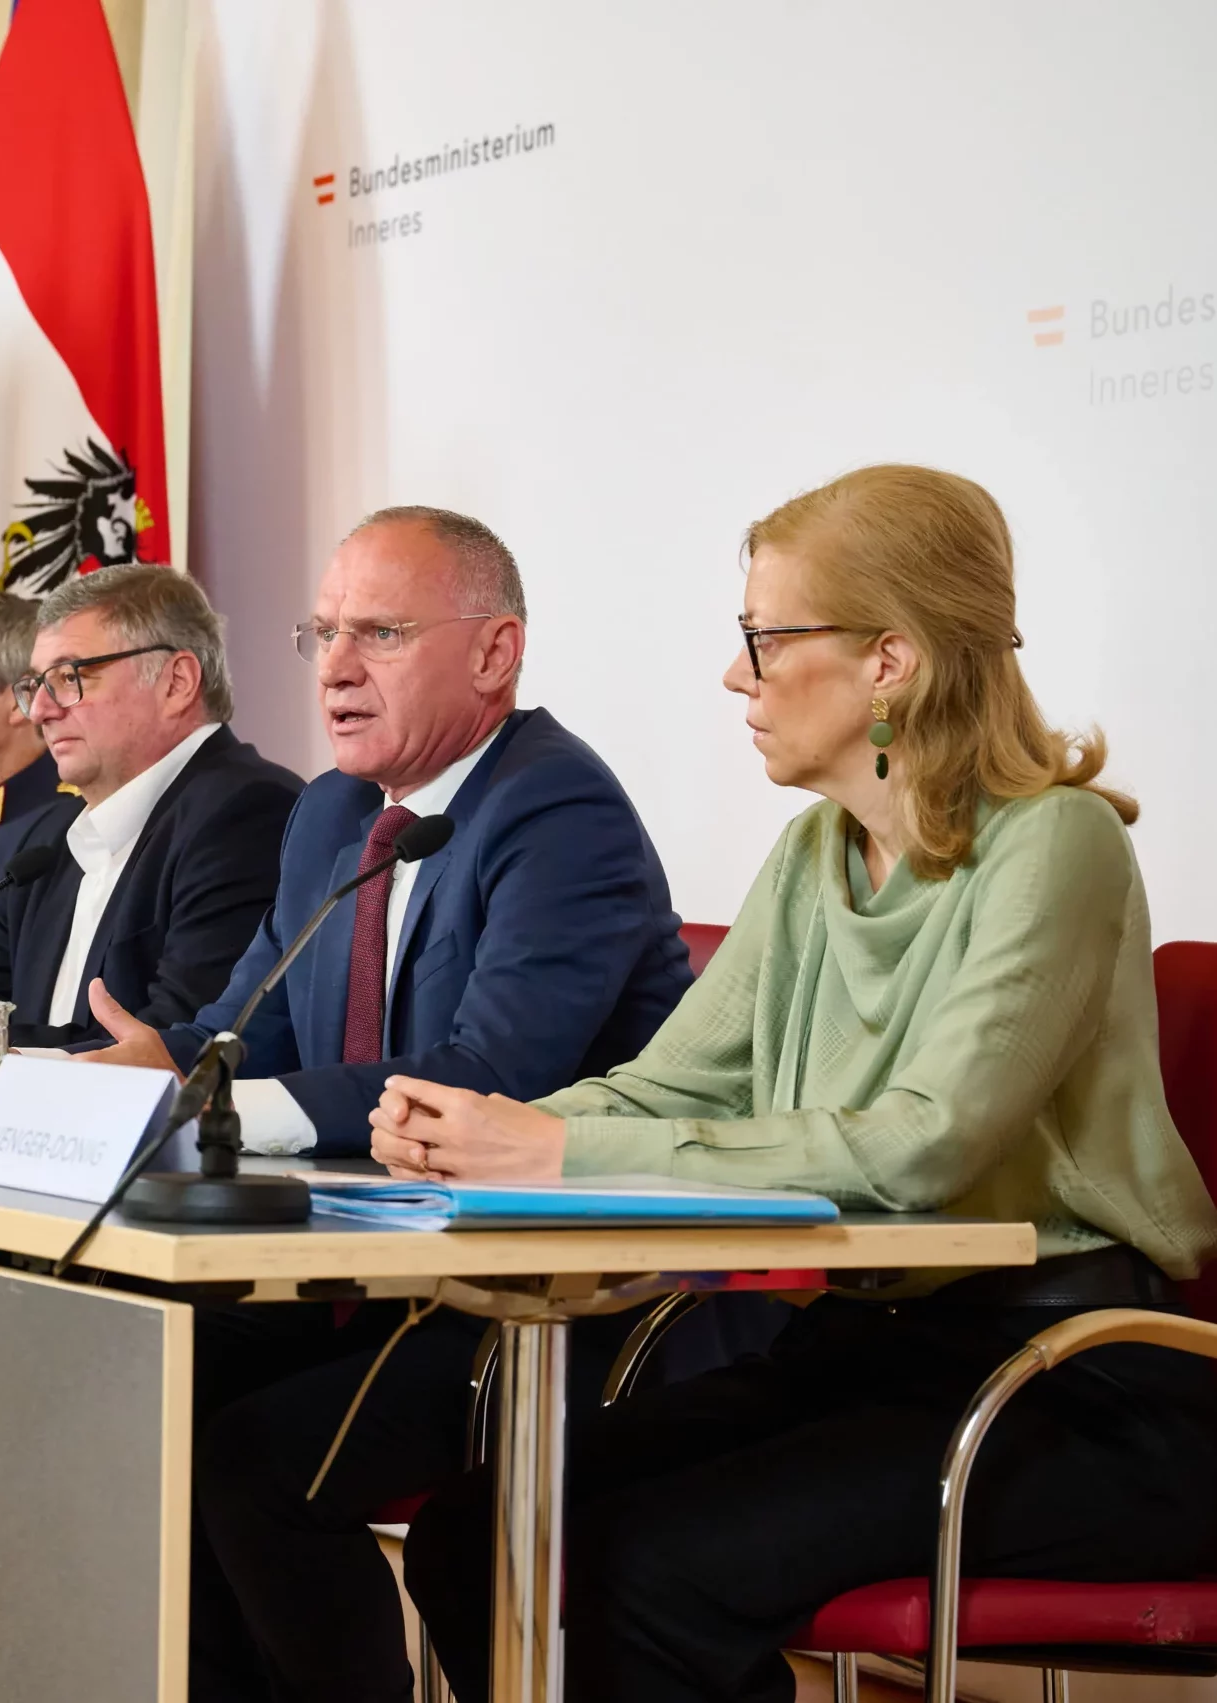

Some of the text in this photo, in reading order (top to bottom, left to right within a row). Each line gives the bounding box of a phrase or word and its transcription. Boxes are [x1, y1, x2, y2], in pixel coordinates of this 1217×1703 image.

[349, 122, 555, 198] Bundesministerium
[348, 210, 423, 249] Inneres
[1090, 283, 1216, 339] Bundes
[1089, 362, 1215, 406] Inneres
